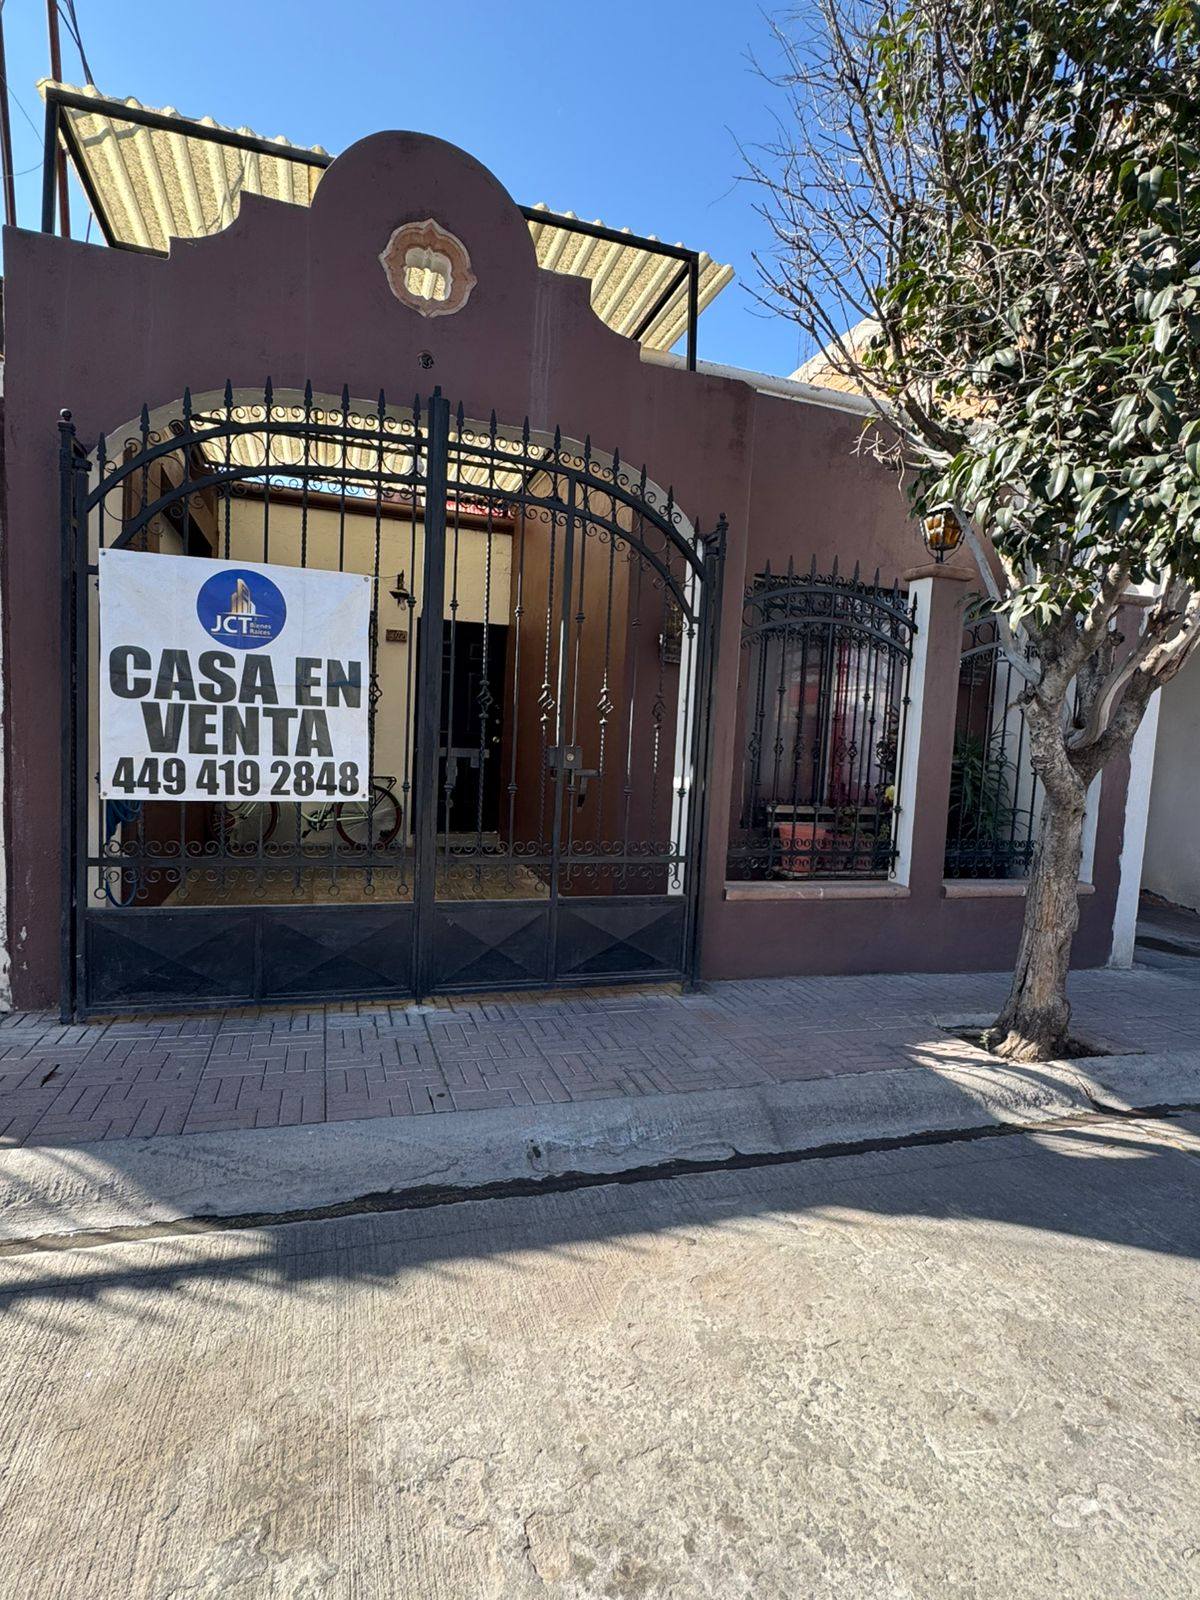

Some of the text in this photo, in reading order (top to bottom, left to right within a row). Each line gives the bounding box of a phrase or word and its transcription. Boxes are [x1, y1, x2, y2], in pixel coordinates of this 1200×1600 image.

[211, 615, 252, 633] JCT
[109, 645, 361, 708] CASA EN
[141, 702, 334, 757] VENTA
[112, 757, 359, 796] 449 419 2848
